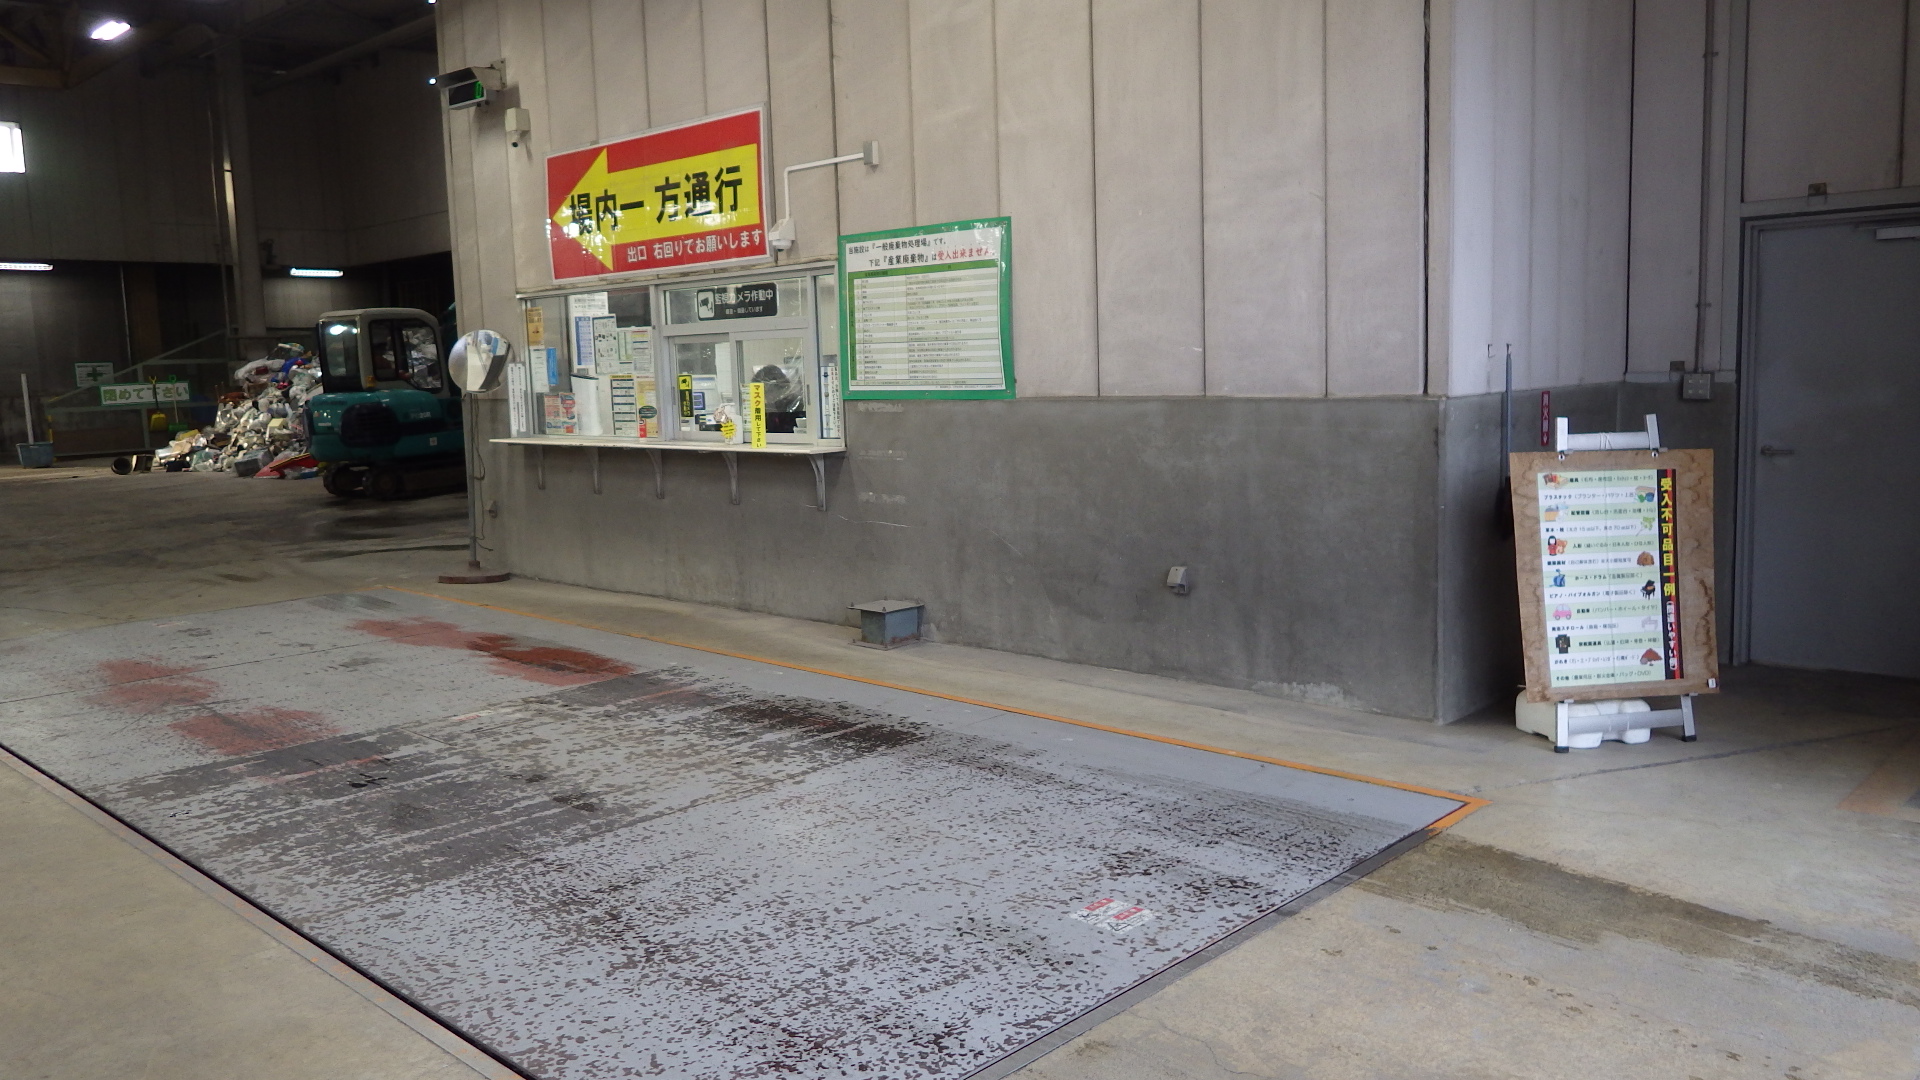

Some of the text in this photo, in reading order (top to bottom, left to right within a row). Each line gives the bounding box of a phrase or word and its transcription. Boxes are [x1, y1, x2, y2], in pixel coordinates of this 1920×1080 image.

[570, 165, 743, 236] 場内一方通行
[627, 229, 763, 263] 出口 右回りでお願いします
[715, 289, 774, 305] 監視カメラ作動中
[753, 385, 763, 447] マスク着用して下さい
[1660, 477, 1676, 596] 受入不可品目一例
